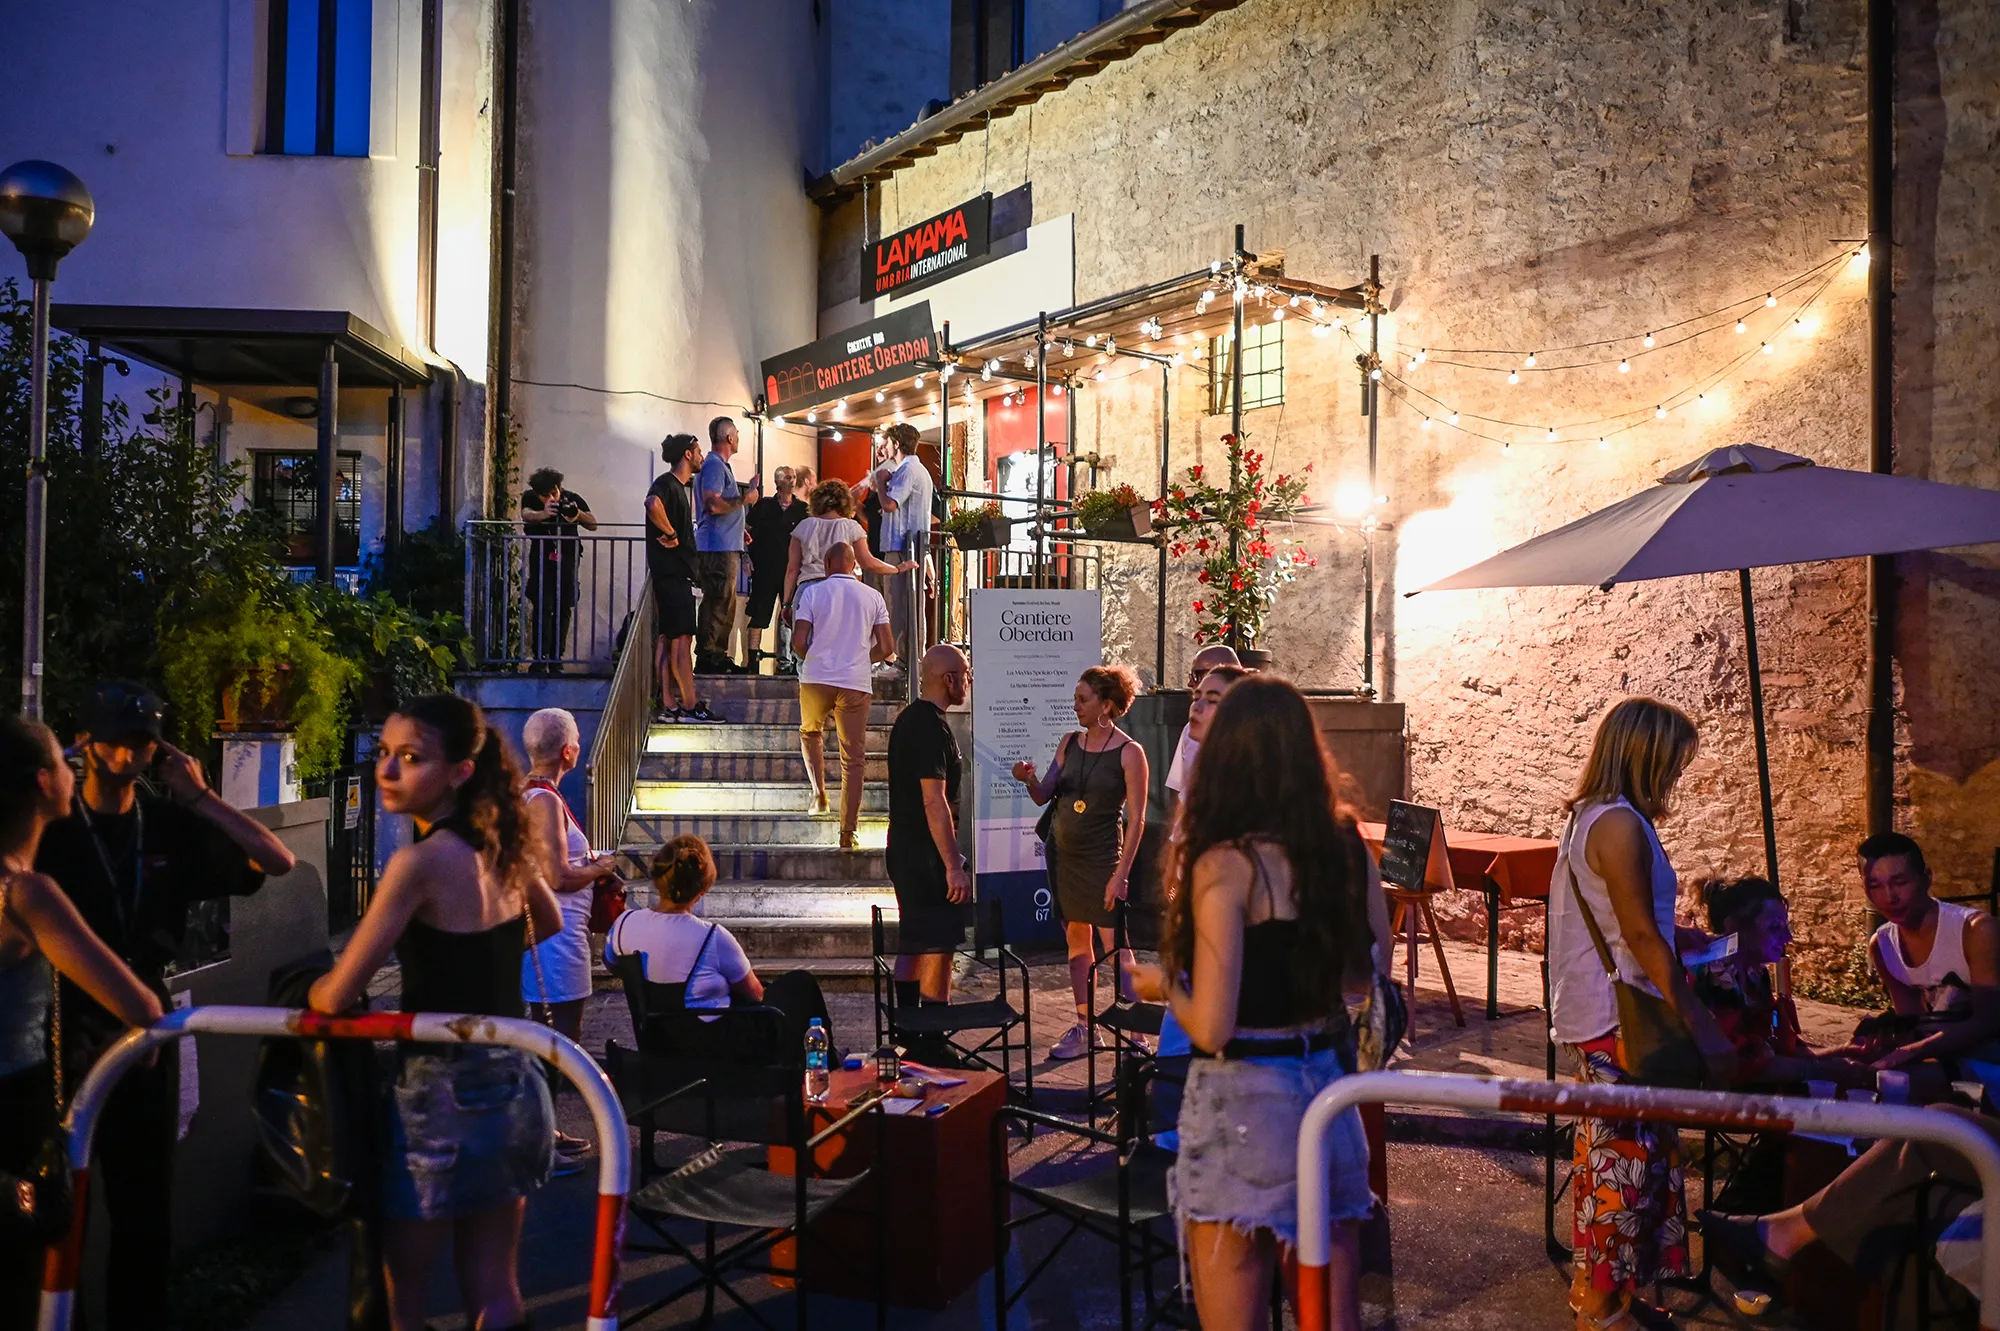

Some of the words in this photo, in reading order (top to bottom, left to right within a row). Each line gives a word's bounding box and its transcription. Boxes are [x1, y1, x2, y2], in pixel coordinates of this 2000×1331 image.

[817, 353, 874, 390] CANTIERE
[873, 336, 930, 372] OBERDAN
[1001, 609, 1071, 626] Cantiere
[999, 626, 1074, 642] Oberdan
[1035, 908, 1050, 922] 67
